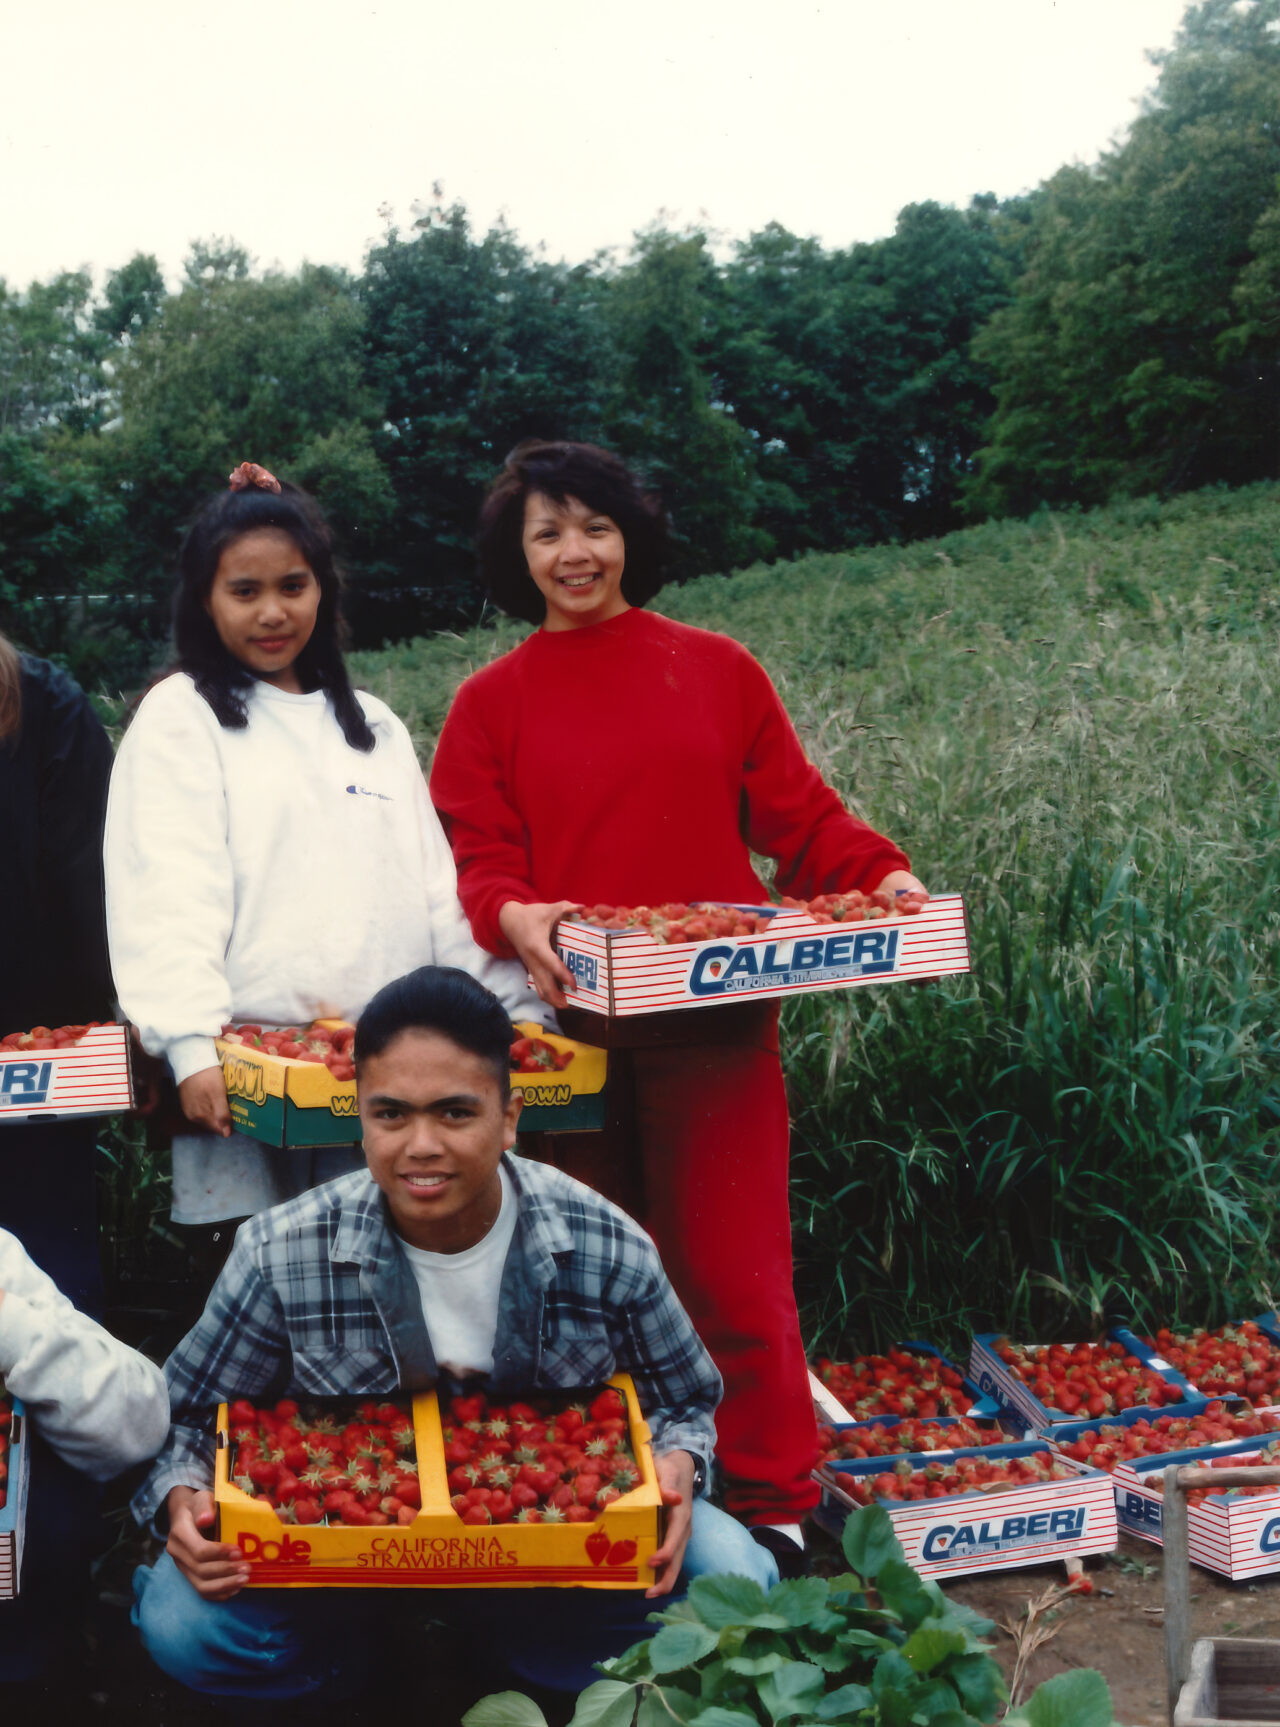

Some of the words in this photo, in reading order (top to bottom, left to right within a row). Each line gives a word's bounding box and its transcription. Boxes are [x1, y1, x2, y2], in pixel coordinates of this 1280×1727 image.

[561, 948, 597, 991] BERI
[690, 930, 899, 995] CALBERI
[223, 1053, 266, 1104] BOWL
[524, 1085, 571, 1104] OWN
[237, 1531, 312, 1563] Dole
[370, 1536, 503, 1552] CALIFORNIA
[923, 1507, 1086, 1562] CALBERI
[357, 1551, 519, 1568] STRAWBERRIES
